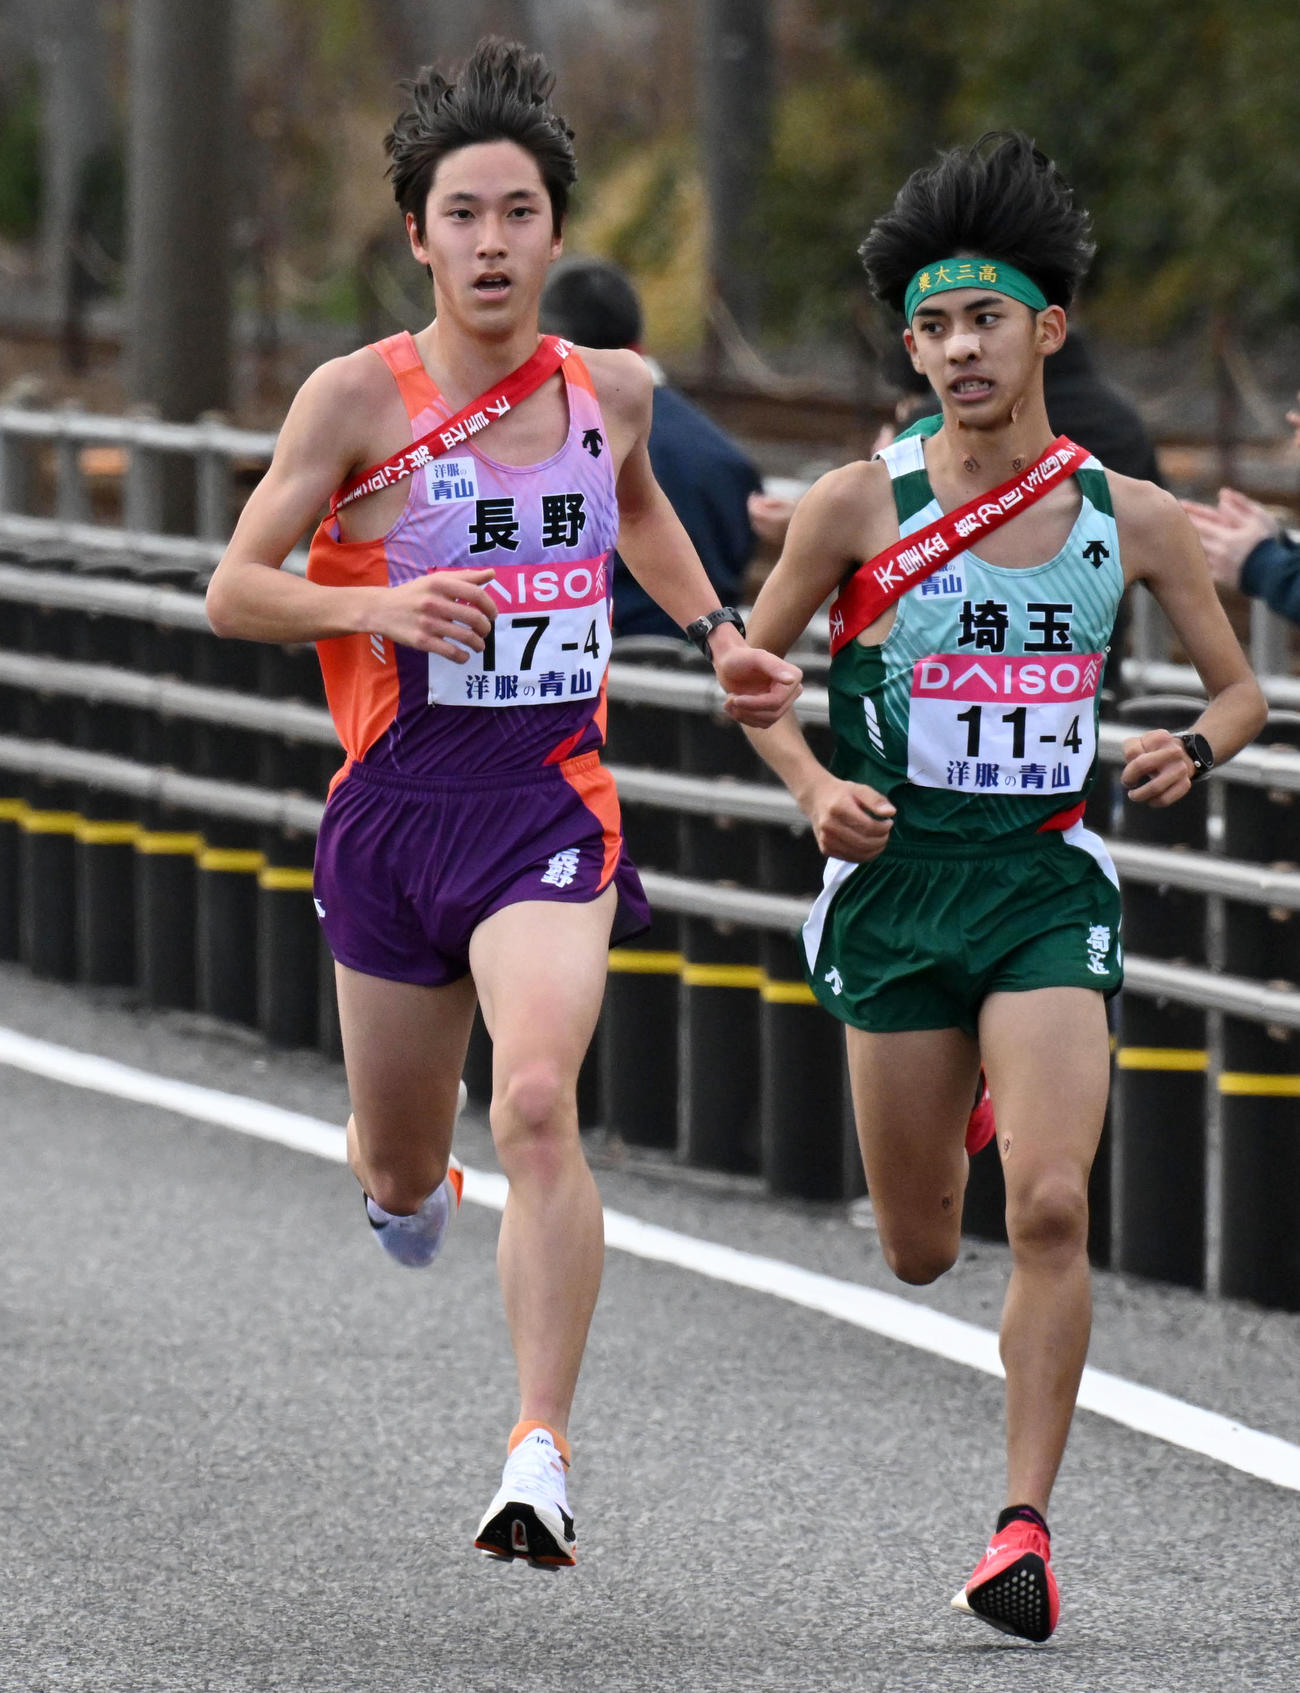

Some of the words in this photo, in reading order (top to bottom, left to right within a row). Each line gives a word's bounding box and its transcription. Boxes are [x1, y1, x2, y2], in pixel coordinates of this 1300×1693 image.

[434, 462, 467, 478] 洋服の
[431, 478, 475, 501] 青山
[468, 491, 587, 554] 長野
[873, 532, 950, 594] 天皇盃
[479, 567, 593, 605] AISO
[921, 573, 963, 596] 青山
[483, 616, 601, 672] 17-4
[957, 599, 1074, 653] 埼玉
[465, 668, 592, 700] 洋服の青山
[919, 661, 1081, 695] DAISO
[956, 705, 1083, 759] 11-4
[946, 760, 1071, 790] 洋服の青山
